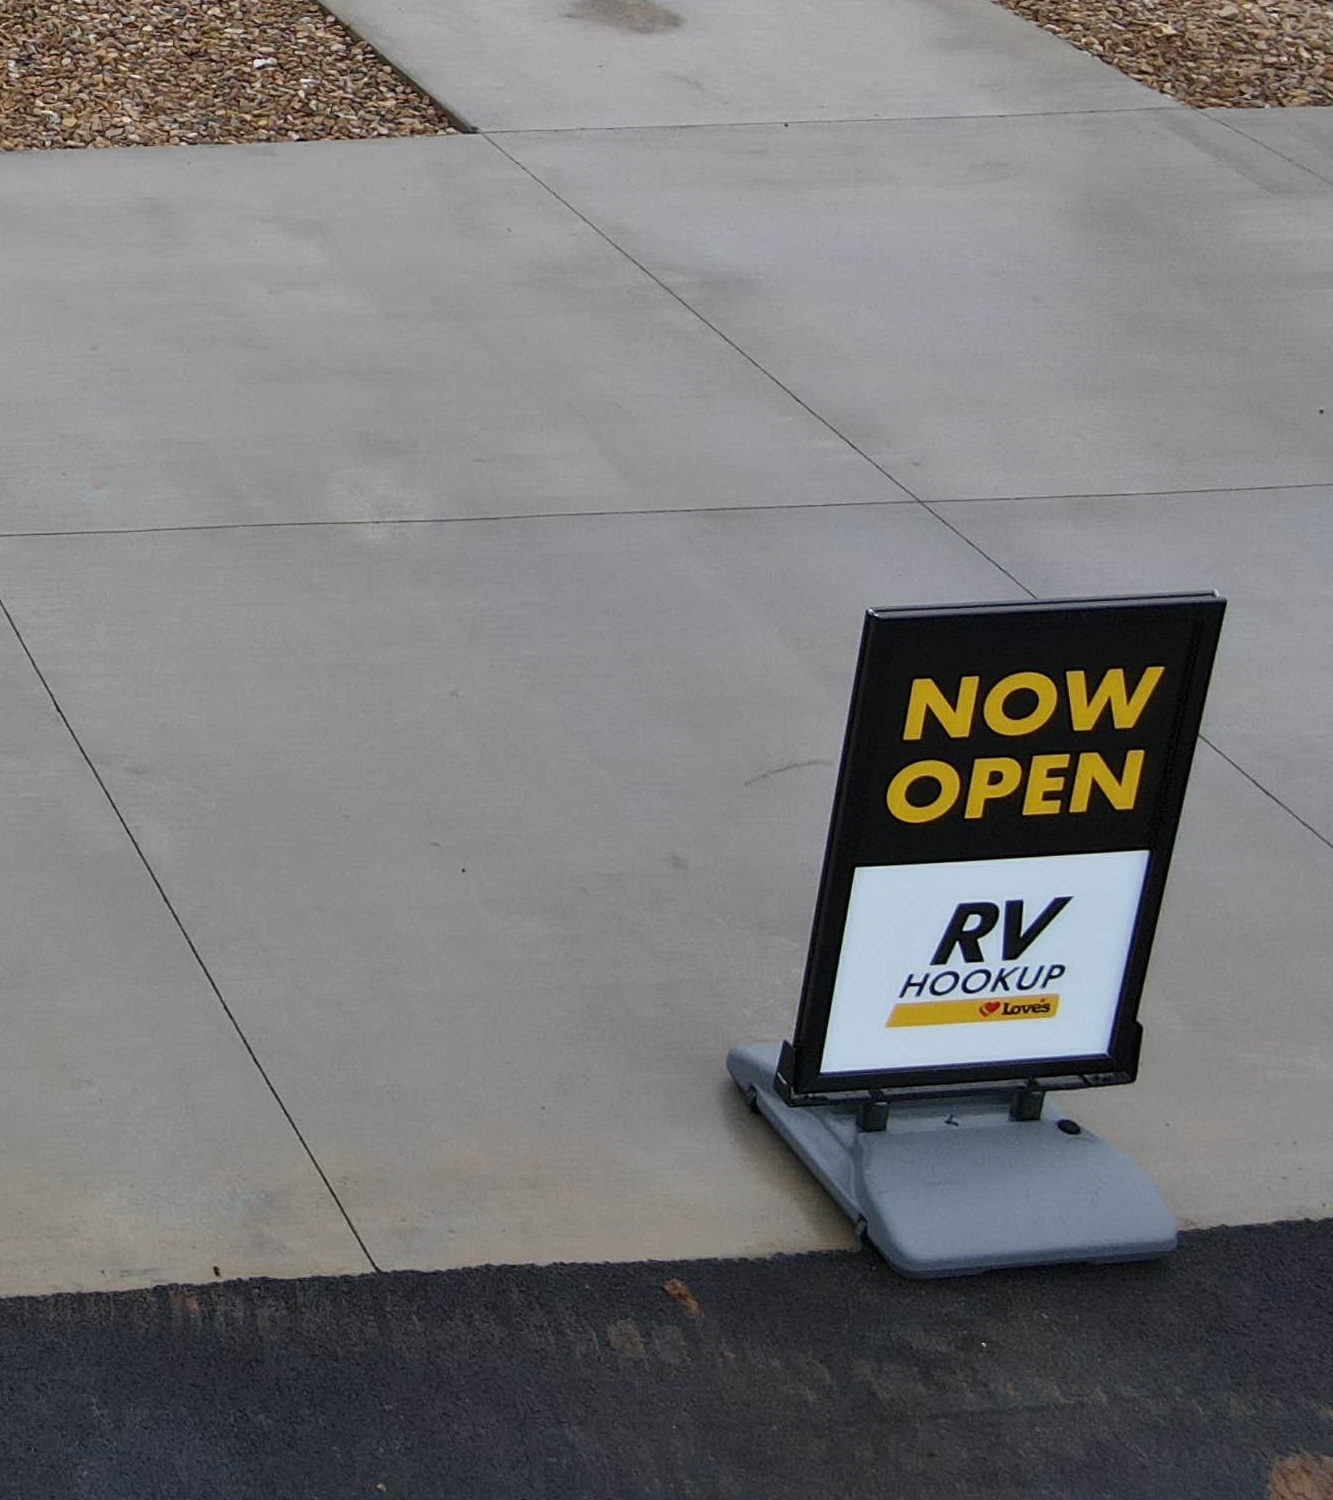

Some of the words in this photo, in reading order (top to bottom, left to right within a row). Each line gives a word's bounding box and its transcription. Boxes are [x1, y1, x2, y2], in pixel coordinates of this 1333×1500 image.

[903, 666, 1166, 741] NOW
[886, 749, 1145, 824] OPEN
[929, 895, 1075, 966] RV
[898, 964, 1067, 999] HOOKUP
